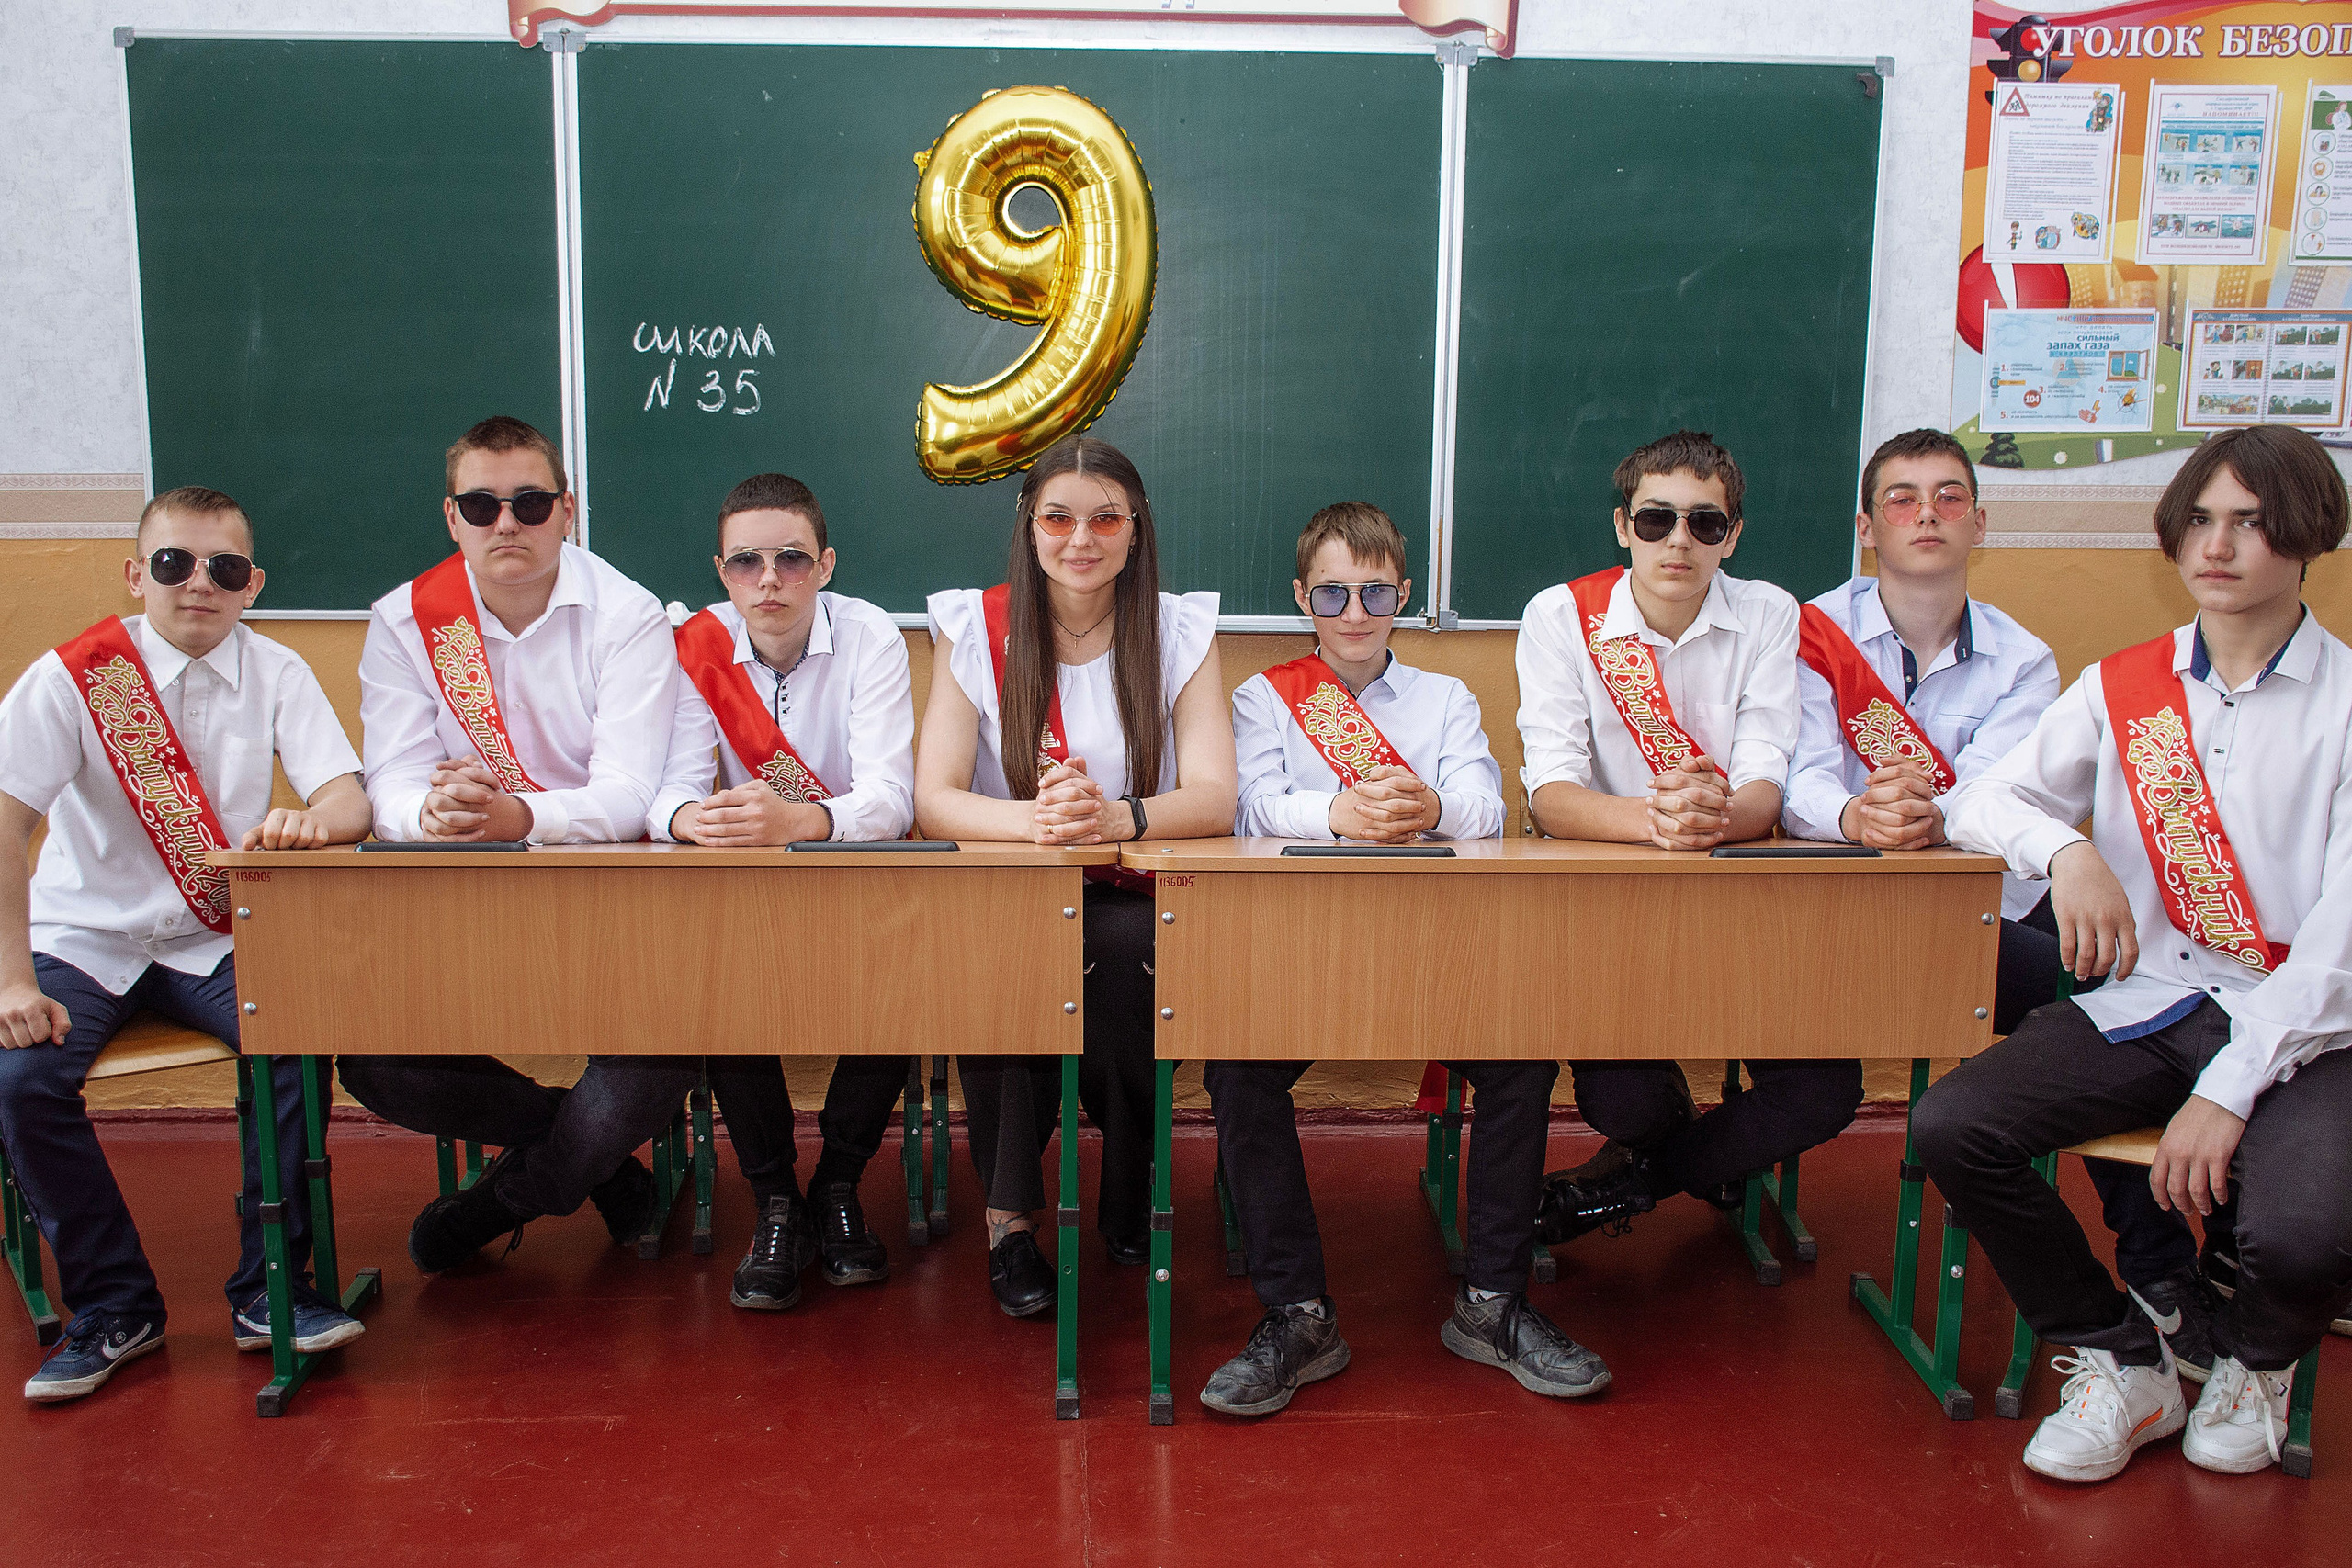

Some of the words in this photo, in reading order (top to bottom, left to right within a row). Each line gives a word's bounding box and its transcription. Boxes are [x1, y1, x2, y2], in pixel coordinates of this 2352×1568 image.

[2032, 24, 2204, 58] УГОЛОК
[913, 85, 1158, 485] 9
[632, 321, 776, 360] ШКОЛА
[696, 369, 761, 415] 35
[2137, 749, 2256, 950] Выпускник
